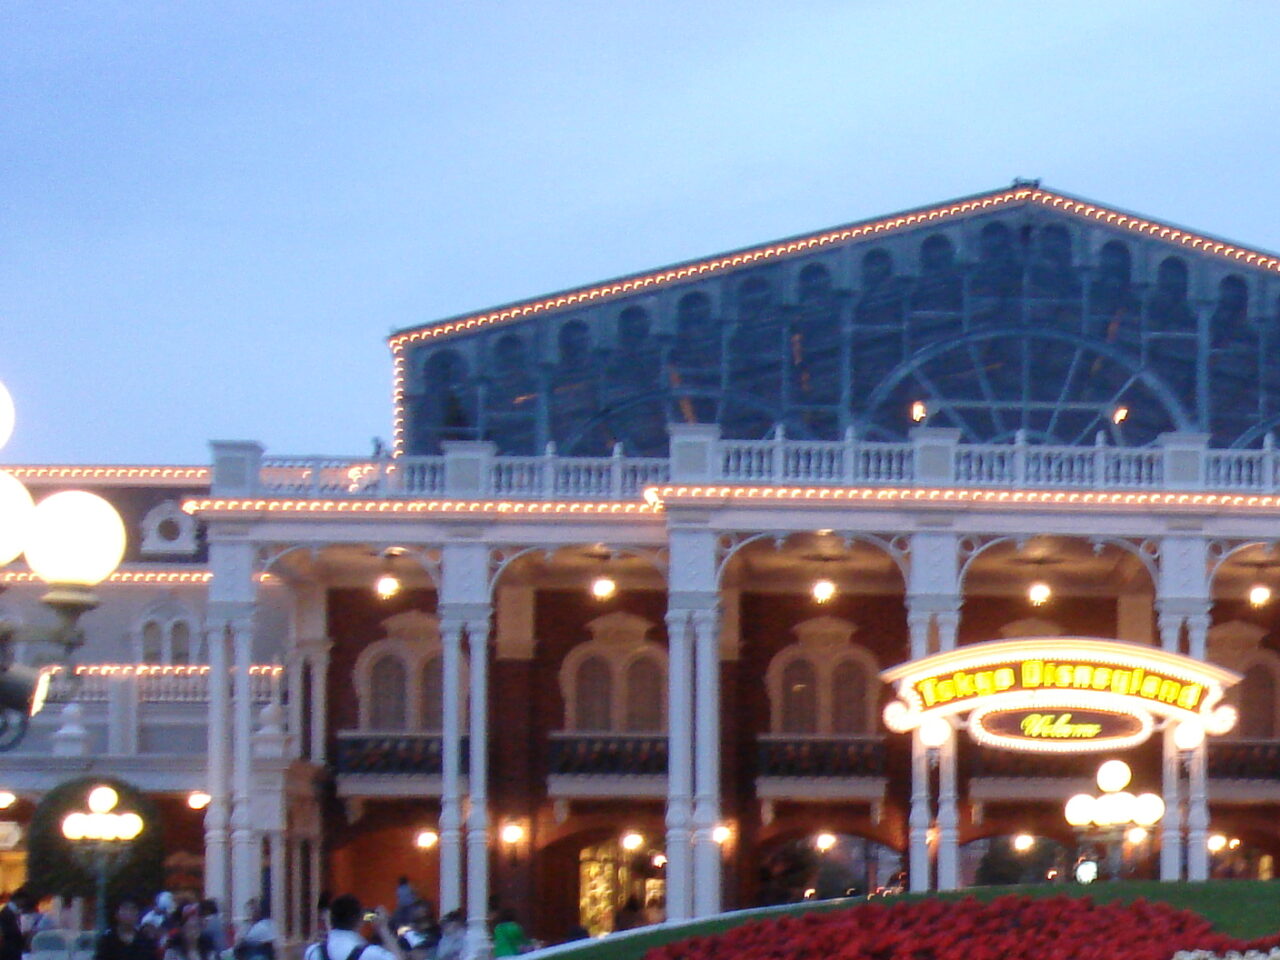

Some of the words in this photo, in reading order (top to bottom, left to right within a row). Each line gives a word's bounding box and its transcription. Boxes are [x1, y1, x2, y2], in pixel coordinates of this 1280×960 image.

[918, 668, 1015, 706] Tokyo
[1021, 660, 1202, 709] Disneyland
[1021, 713, 1102, 738] Welcome
